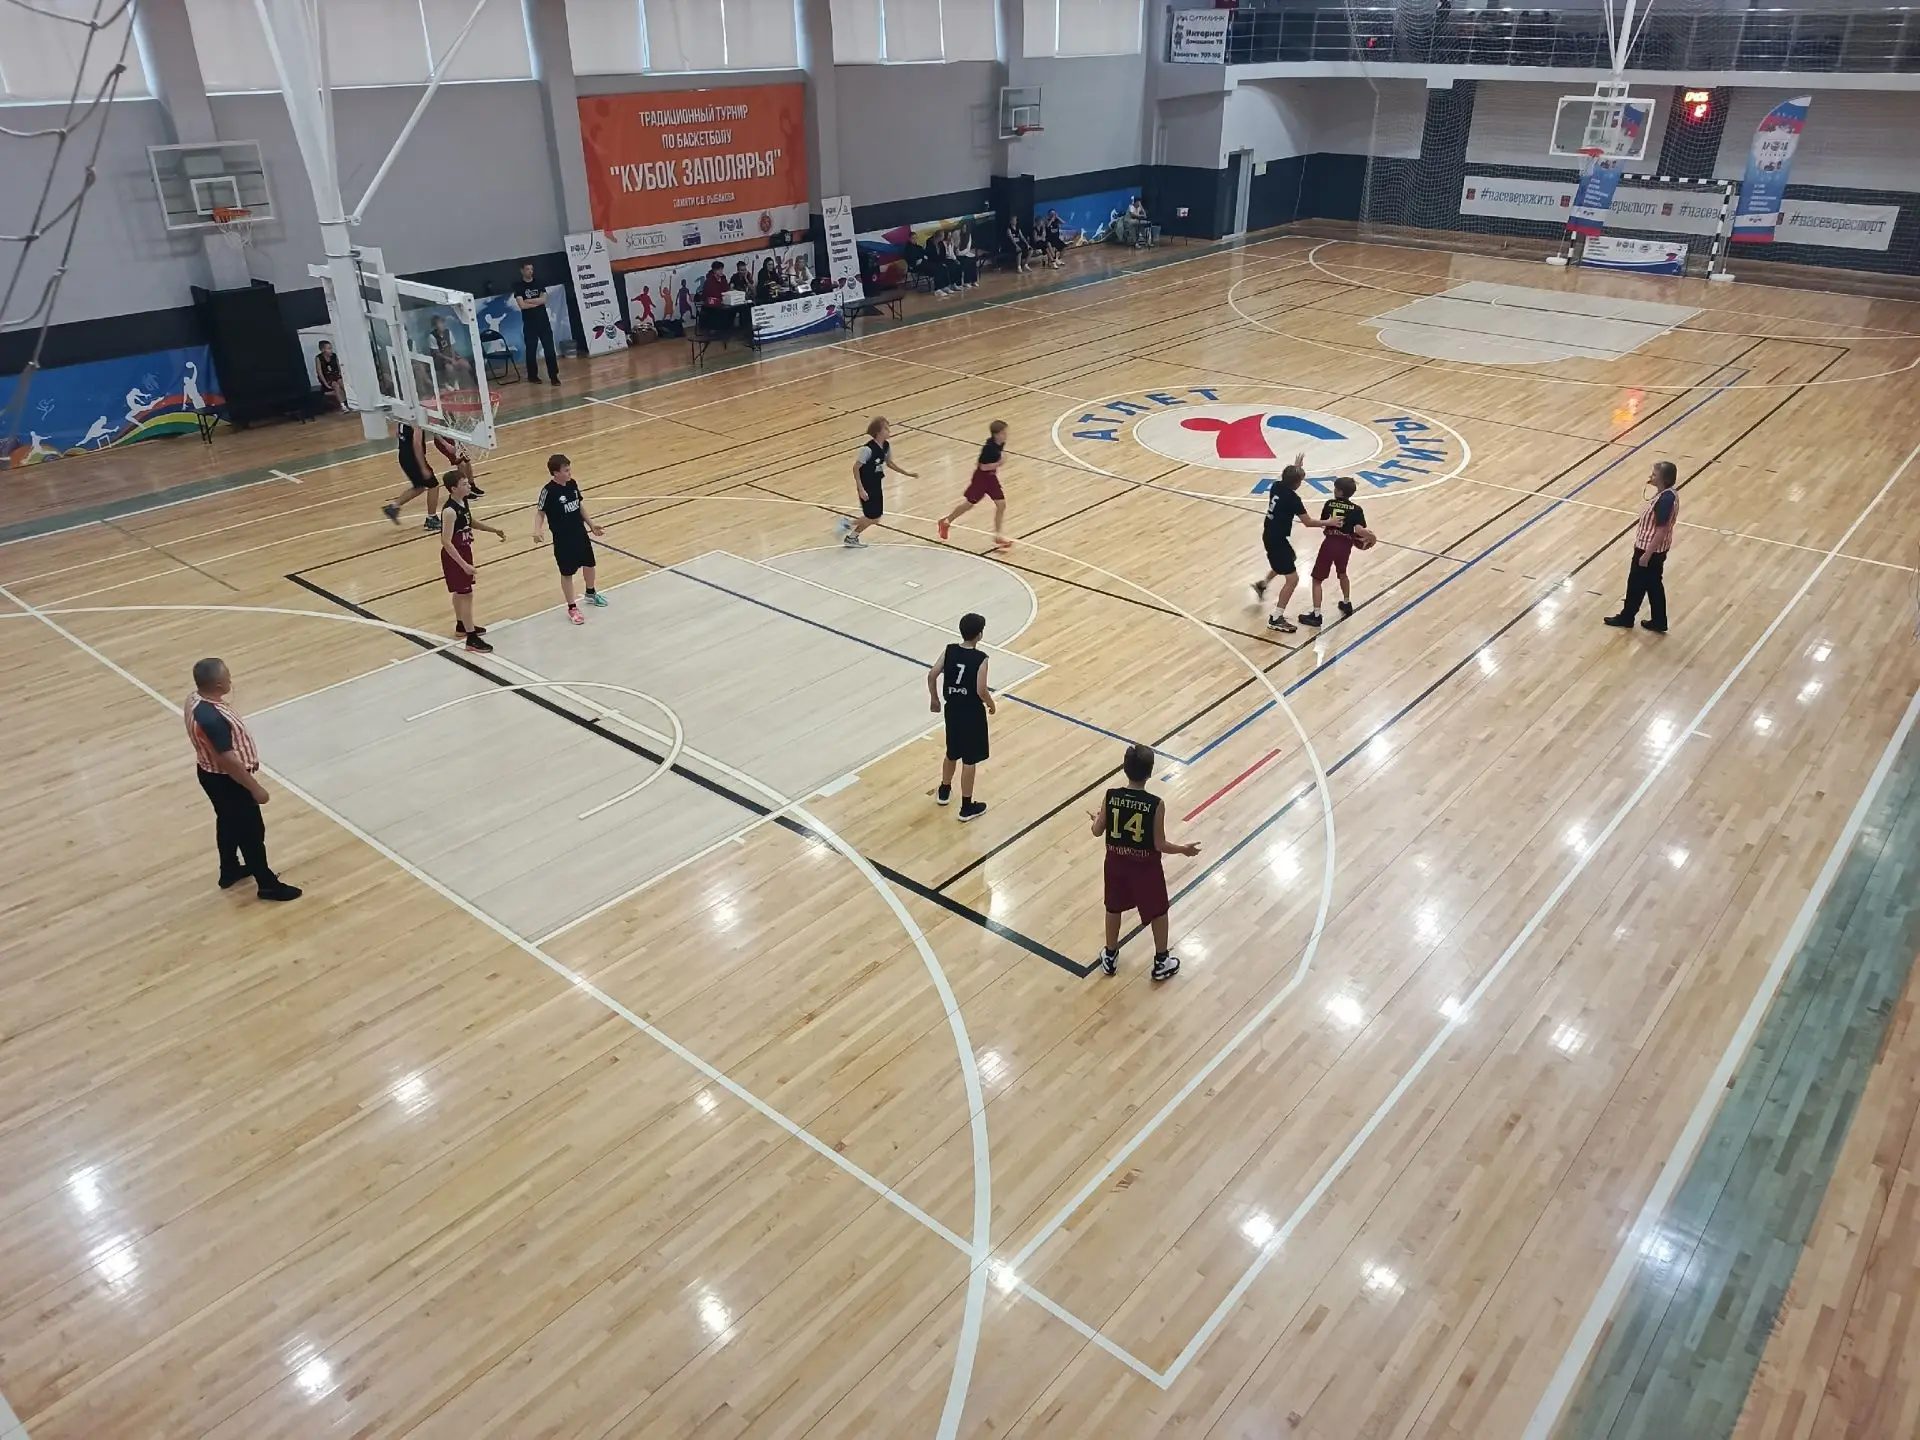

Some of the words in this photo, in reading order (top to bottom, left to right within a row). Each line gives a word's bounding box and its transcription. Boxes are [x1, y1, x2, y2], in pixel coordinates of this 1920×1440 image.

[1186, 29, 1224, 38] Интернет
[639, 105, 715, 127] ТРАДИЦИОННЫЙ
[716, 104, 749, 121] ТУРНИР
[662, 134, 676, 149] ПО
[676, 129, 732, 148] БАСКЕТБОЛУ
[610, 160, 679, 192] "КУБОК
[682, 149, 781, 186] ЗАПОЛЯРЬЯ"
[1072, 388, 1221, 442] АТЛЕТ
[956, 663, 966, 685] 7
[1108, 796, 1152, 813] АПАТИТЫ
[1110, 807, 1145, 843] 14
